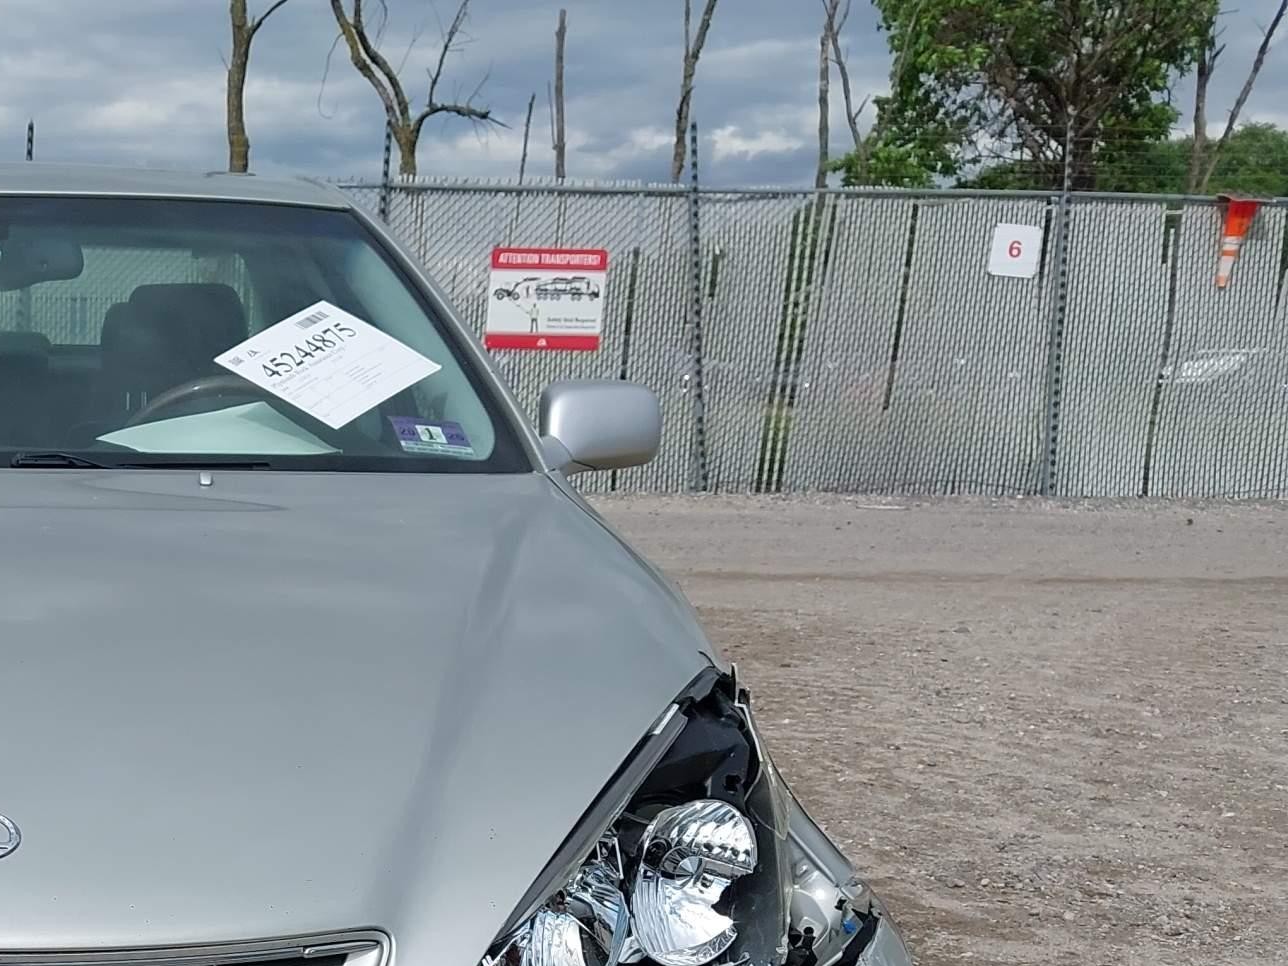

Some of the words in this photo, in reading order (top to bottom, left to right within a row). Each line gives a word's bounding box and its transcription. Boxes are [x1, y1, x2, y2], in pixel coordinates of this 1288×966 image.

[1008, 240, 1022, 258] 6
[498, 252, 540, 265] ATTENTION
[261, 322, 357, 380] 45244875
[424, 427, 437, 441] 1
